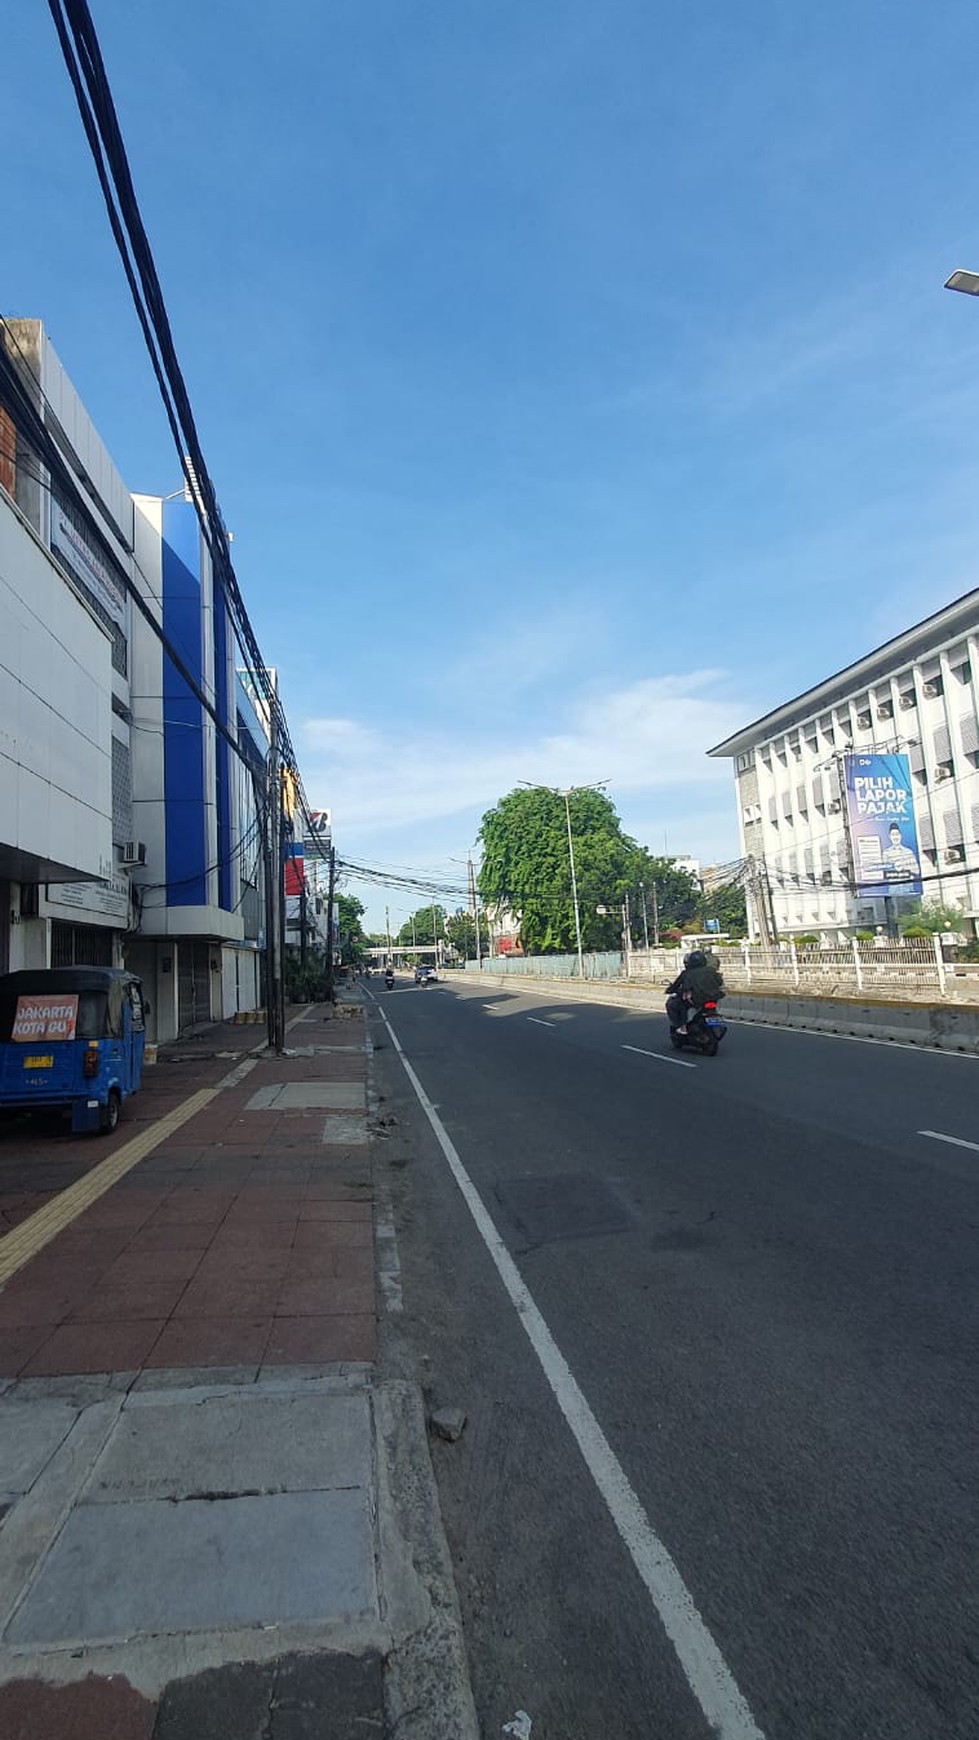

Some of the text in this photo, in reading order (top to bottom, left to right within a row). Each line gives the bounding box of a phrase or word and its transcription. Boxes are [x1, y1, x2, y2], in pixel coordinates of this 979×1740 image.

[854, 777, 894, 789] PILIH
[855, 789, 907, 801] LAPOR
[857, 801, 907, 814] PAJAK
[17, 1005, 73, 1019] JAKARTA
[12, 1021, 45, 1035] KOTA
